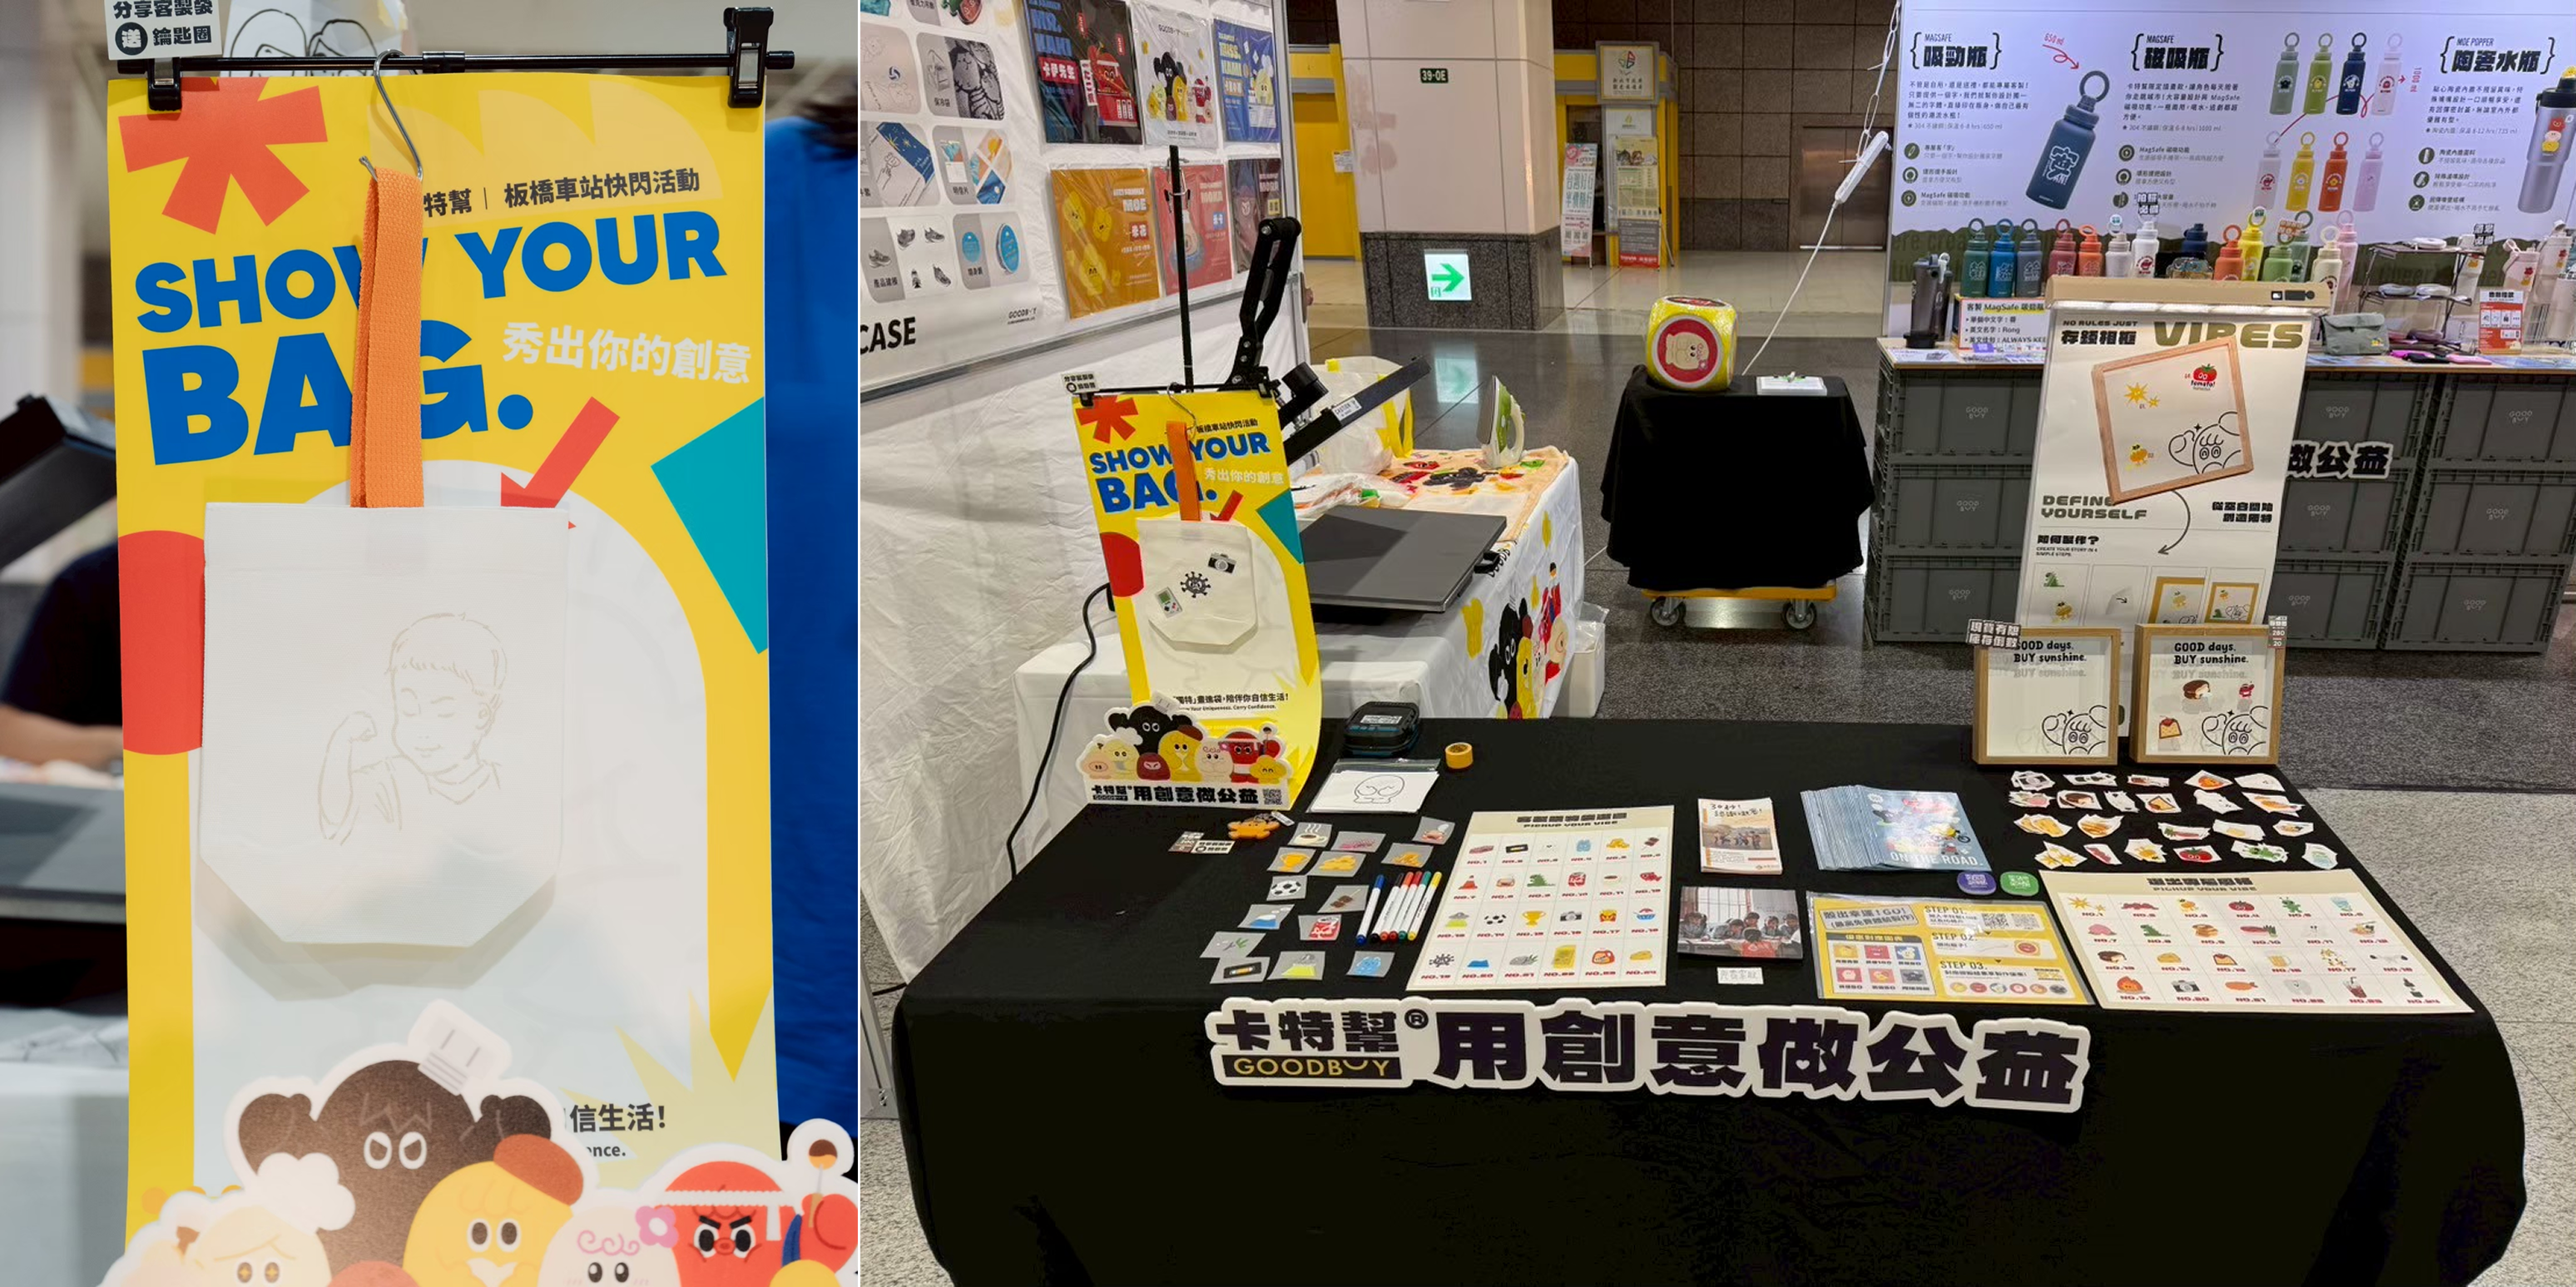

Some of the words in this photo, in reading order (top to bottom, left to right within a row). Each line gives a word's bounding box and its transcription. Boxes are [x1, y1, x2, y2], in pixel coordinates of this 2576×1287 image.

[152, 25, 212, 46] 鑰匙圈
[2451, 49, 2542, 72] 陶瓷水瓶
[503, 168, 700, 209] 板橋車站快閃活動
[453, 210, 727, 299] YOUR
[1984, 304, 2019, 312] MagSafe
[502, 321, 751, 384] 秀出你的創意
[1189, 432, 1271, 463] YOUR
[1204, 468, 1284, 485] 秀出你的創意
[2041, 507, 2147, 520] YOURSELF
[2047, 641, 2074, 651] days.
[2174, 642, 2205, 651] GOOD
[2208, 642, 2236, 653] days.
[2014, 653, 2035, 662] BUY
[2039, 652, 2087, 662] sunshine.
[2174, 655, 2197, 664] BUY
[2200, 654, 2249, 664] sunshine.
[1134, 785, 1259, 804] 用創意做公益
[1890, 852, 1909, 862] ON
[1942, 855, 1984, 866] ROAD.
[1939, 961, 1966, 969] STEP
[1969, 961, 1988, 970] 03.
[1216, 1009, 1399, 1053] 卡特幫
[1433, 1012, 2079, 1105] 用創意做公益
[563, 1102, 666, 1133] 信生活!
